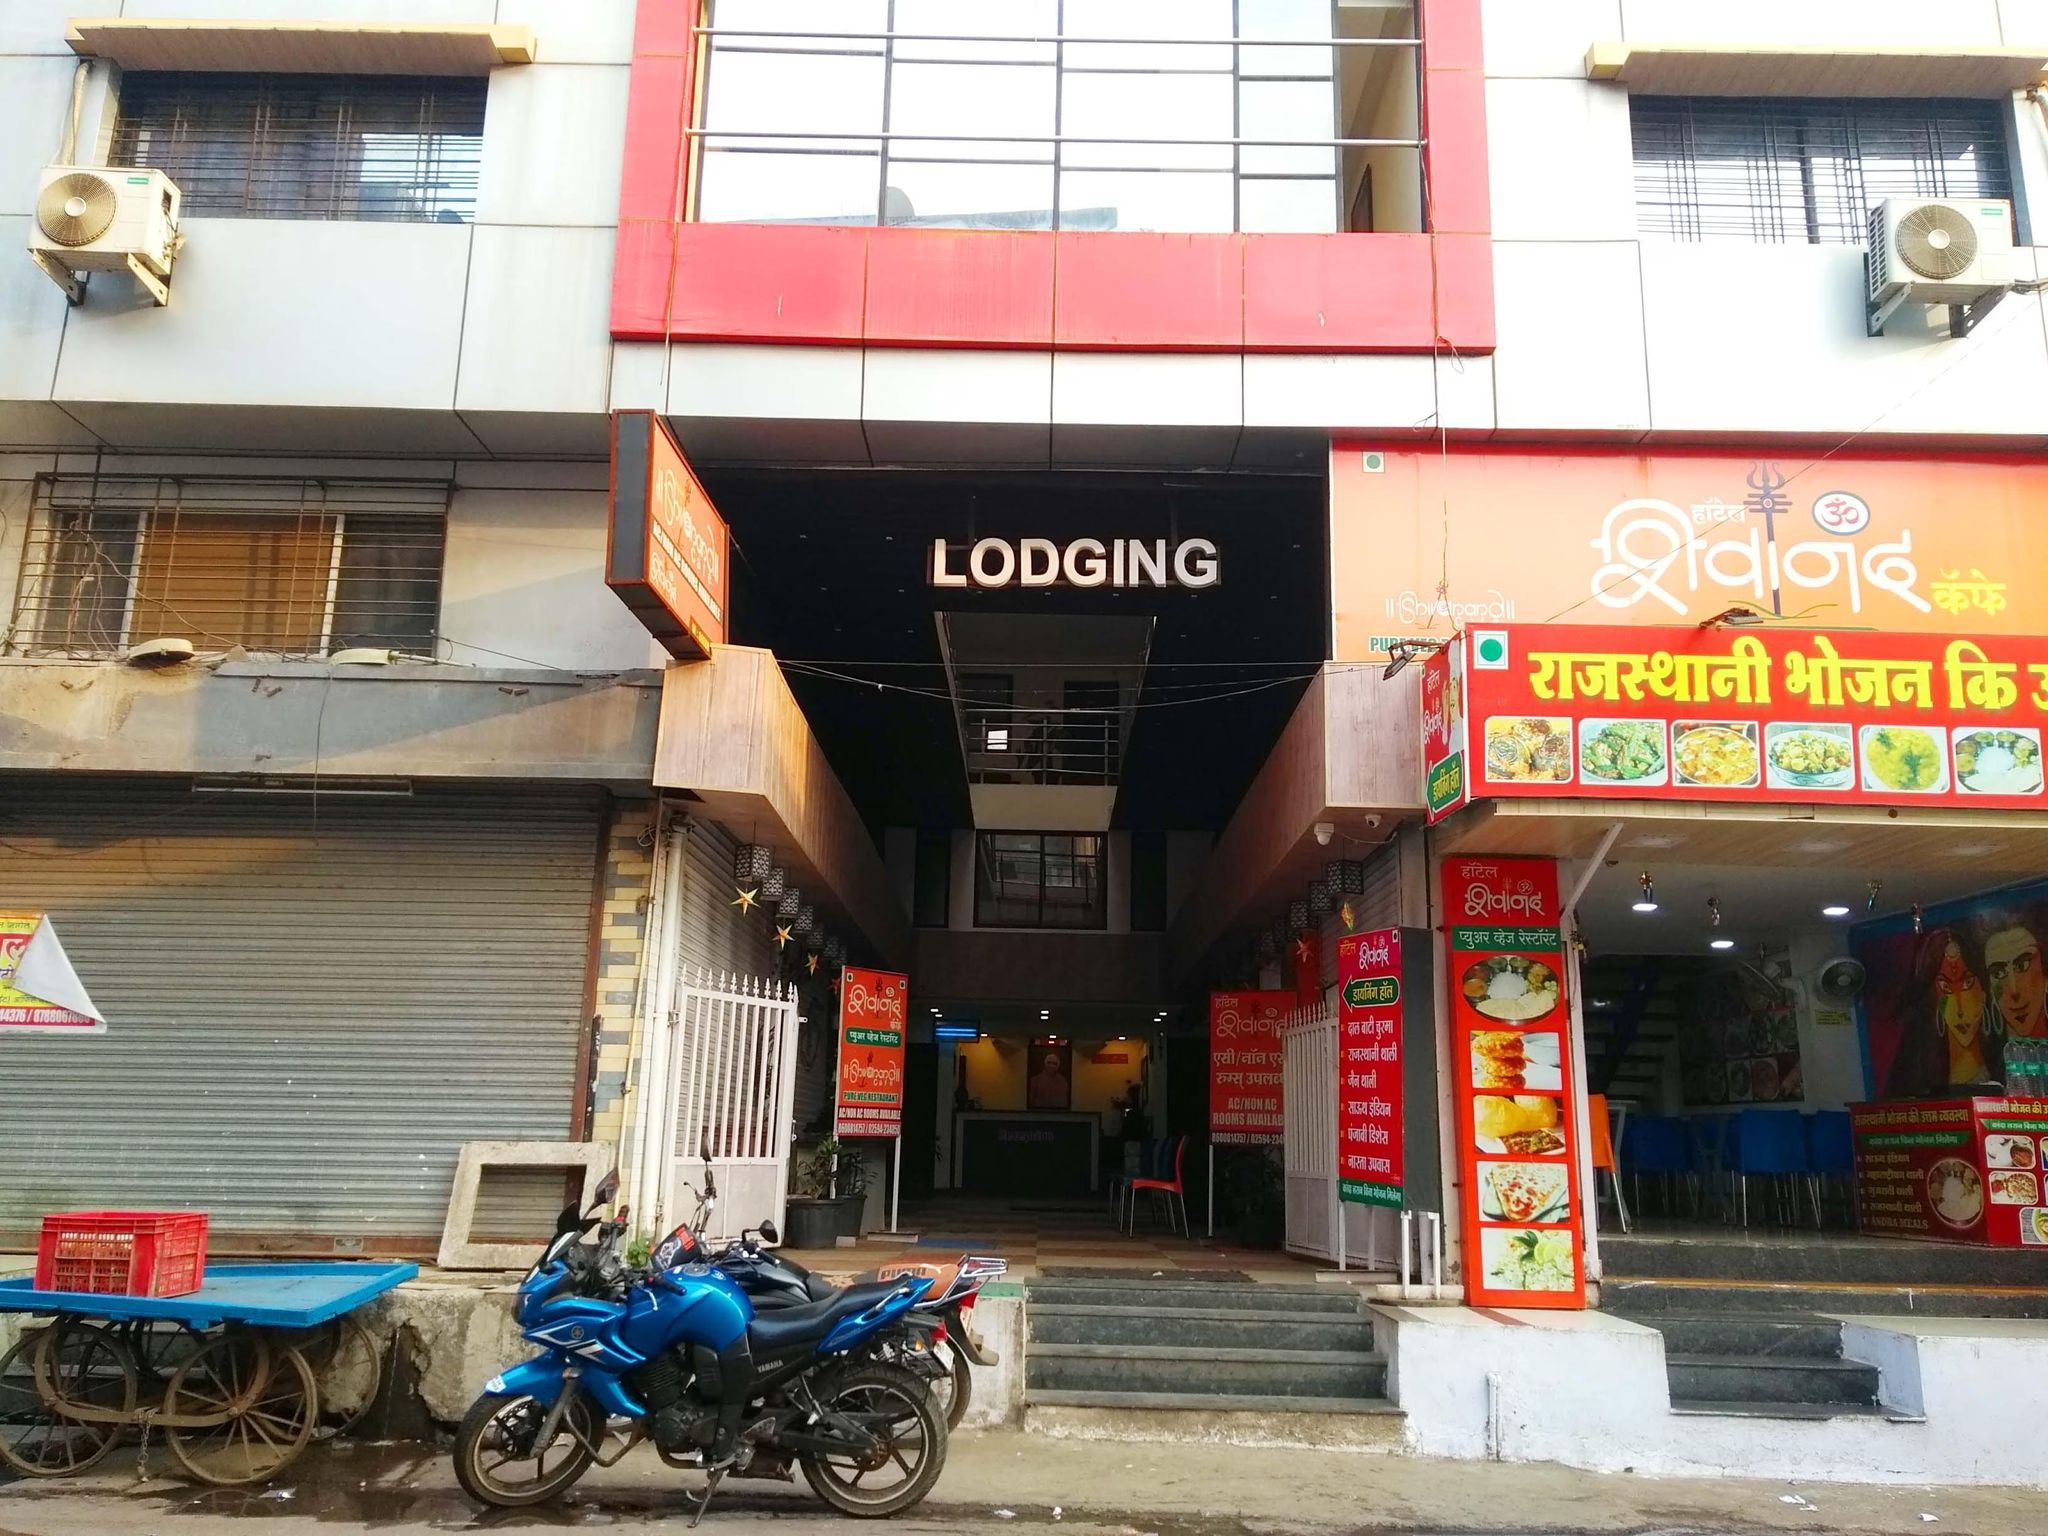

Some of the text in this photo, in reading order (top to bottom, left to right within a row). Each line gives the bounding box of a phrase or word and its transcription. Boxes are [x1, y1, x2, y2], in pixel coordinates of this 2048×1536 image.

[1691, 497, 1747, 524] हॉटेल
[933, 537, 1218, 588] LODGING
[1929, 568, 2008, 616] कॅफे
[1528, 636, 1771, 703] राजस्थानी
[1785, 636, 1933, 708] भोजन
[1944, 640, 2016, 709] कि
[1461, 862, 1498, 879] हॉटेल
[1459, 928, 1557, 949] प्युअर व्हेज रेस्टॉरंट
[1348, 1041, 1397, 1061] राजस्थानी थाली
[1361, 1069, 1376, 1088] थाली
[1228, 1098, 1277, 1110] AC/NON AC
[1213, 1112, 1244, 1125] ROOMS
[757, 1359, 784, 1373] YAMAHA
